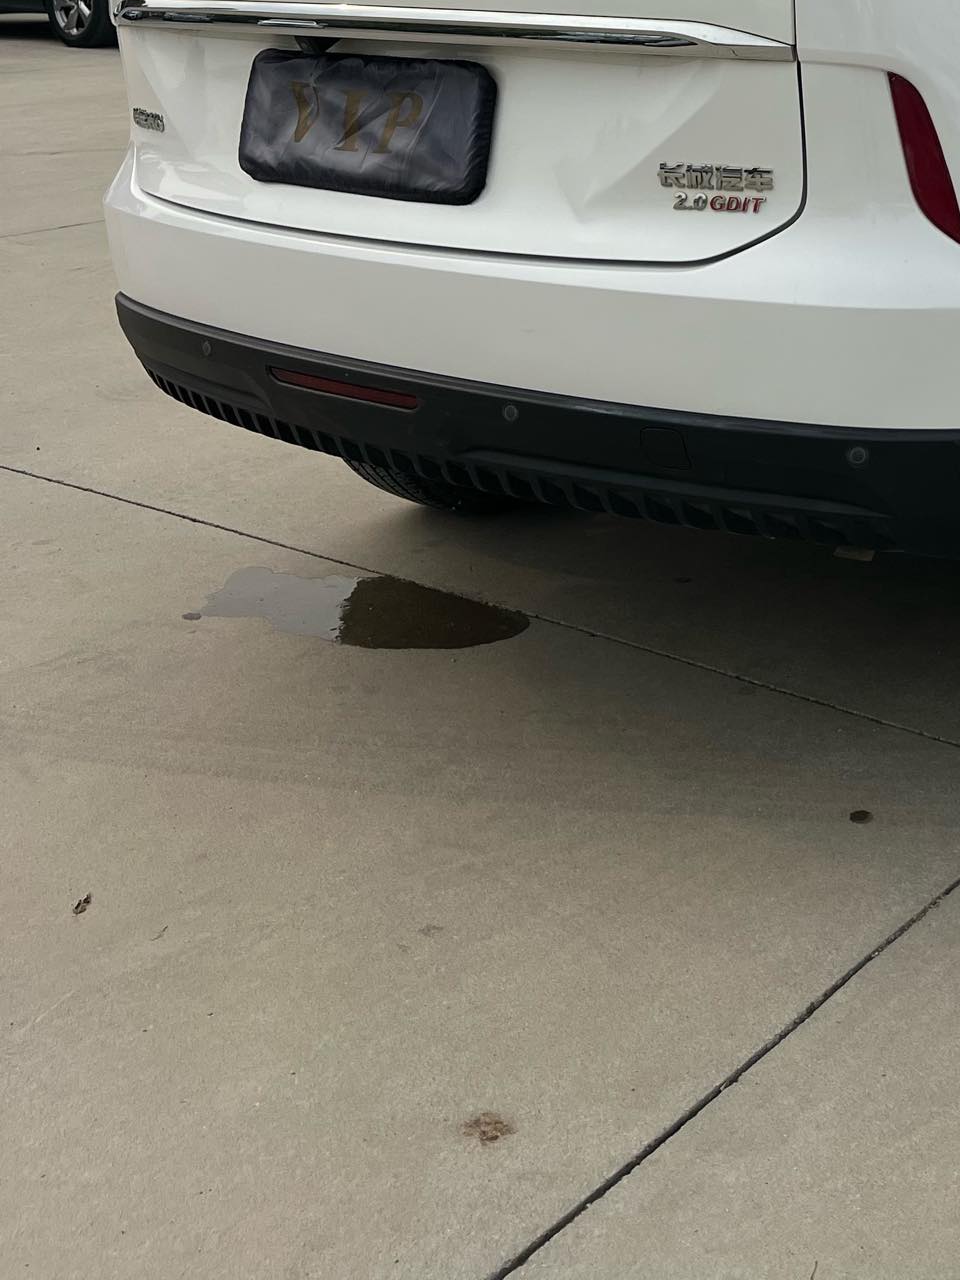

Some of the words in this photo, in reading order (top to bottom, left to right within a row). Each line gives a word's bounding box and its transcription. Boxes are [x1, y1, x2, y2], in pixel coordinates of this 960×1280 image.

[289, 81, 424, 154] VIP
[657, 162, 774, 192] 长城汽车
